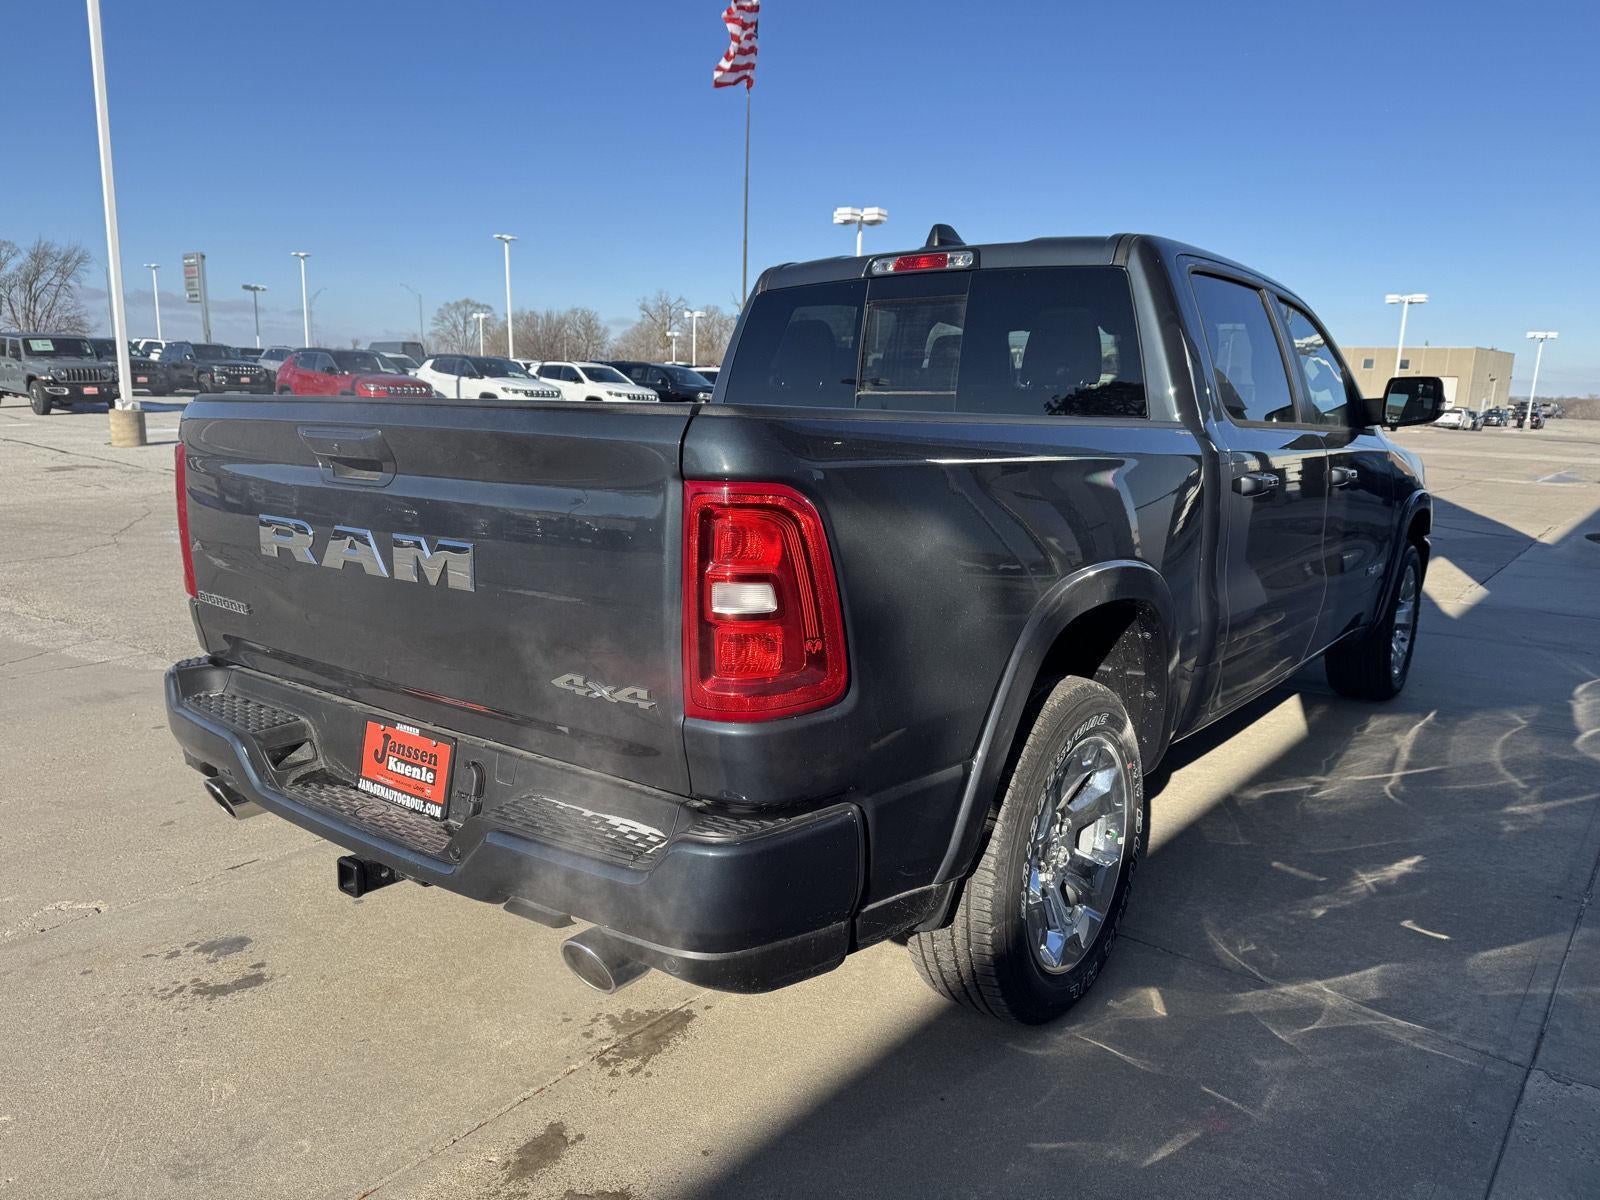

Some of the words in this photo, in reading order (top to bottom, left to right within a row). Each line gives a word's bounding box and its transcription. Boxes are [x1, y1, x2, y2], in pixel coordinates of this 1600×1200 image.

[258, 513, 476, 592] RAM
[395, 722, 420, 736] JANSSEN
[374, 733, 438, 767] Janssen
[387, 756, 435, 784] Kuenle
